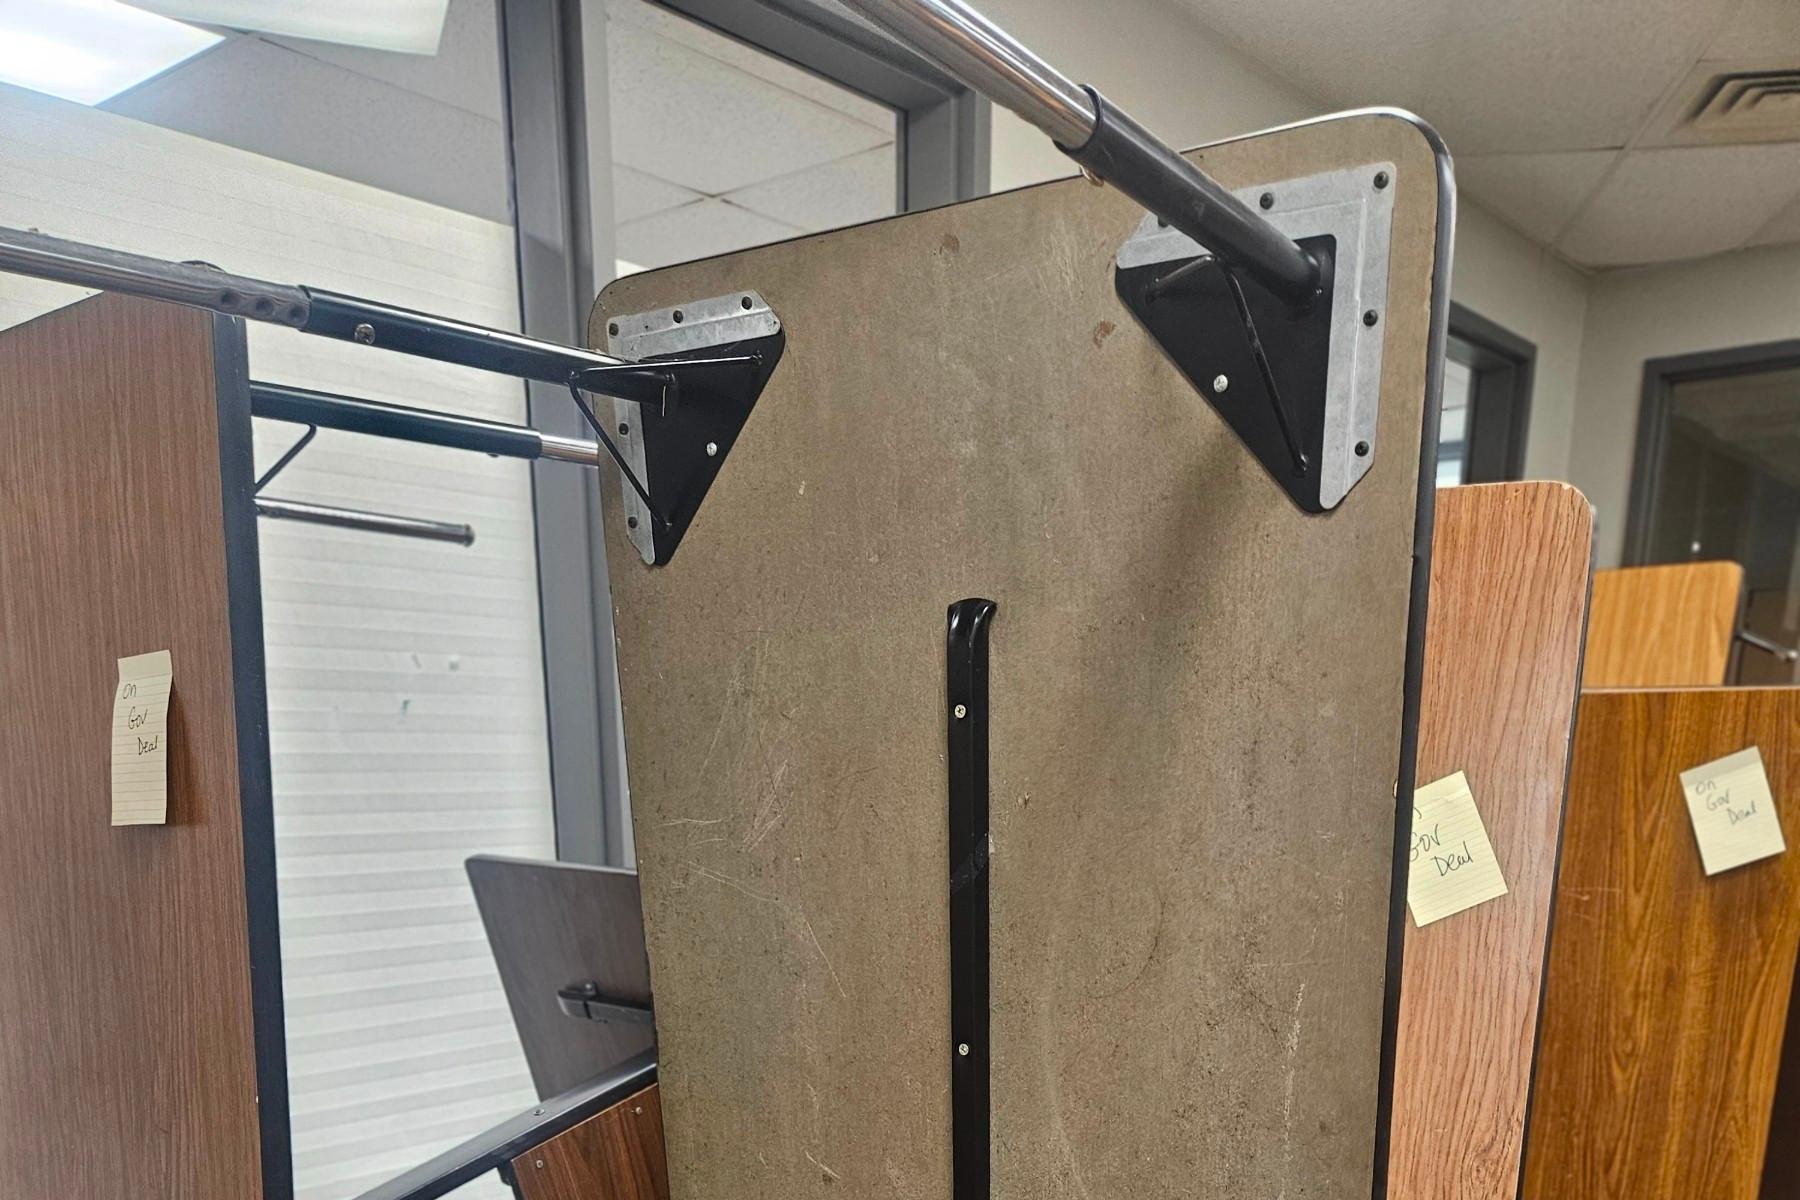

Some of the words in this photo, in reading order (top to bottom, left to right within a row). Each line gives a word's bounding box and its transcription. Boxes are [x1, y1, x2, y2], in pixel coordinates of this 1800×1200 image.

[128, 706, 148, 730] Gov
[137, 734, 159, 756] Deal
[1706, 787, 1730, 812] Gov
[1726, 799, 1758, 826] Deal
[1430, 840, 1474, 877] Deal
